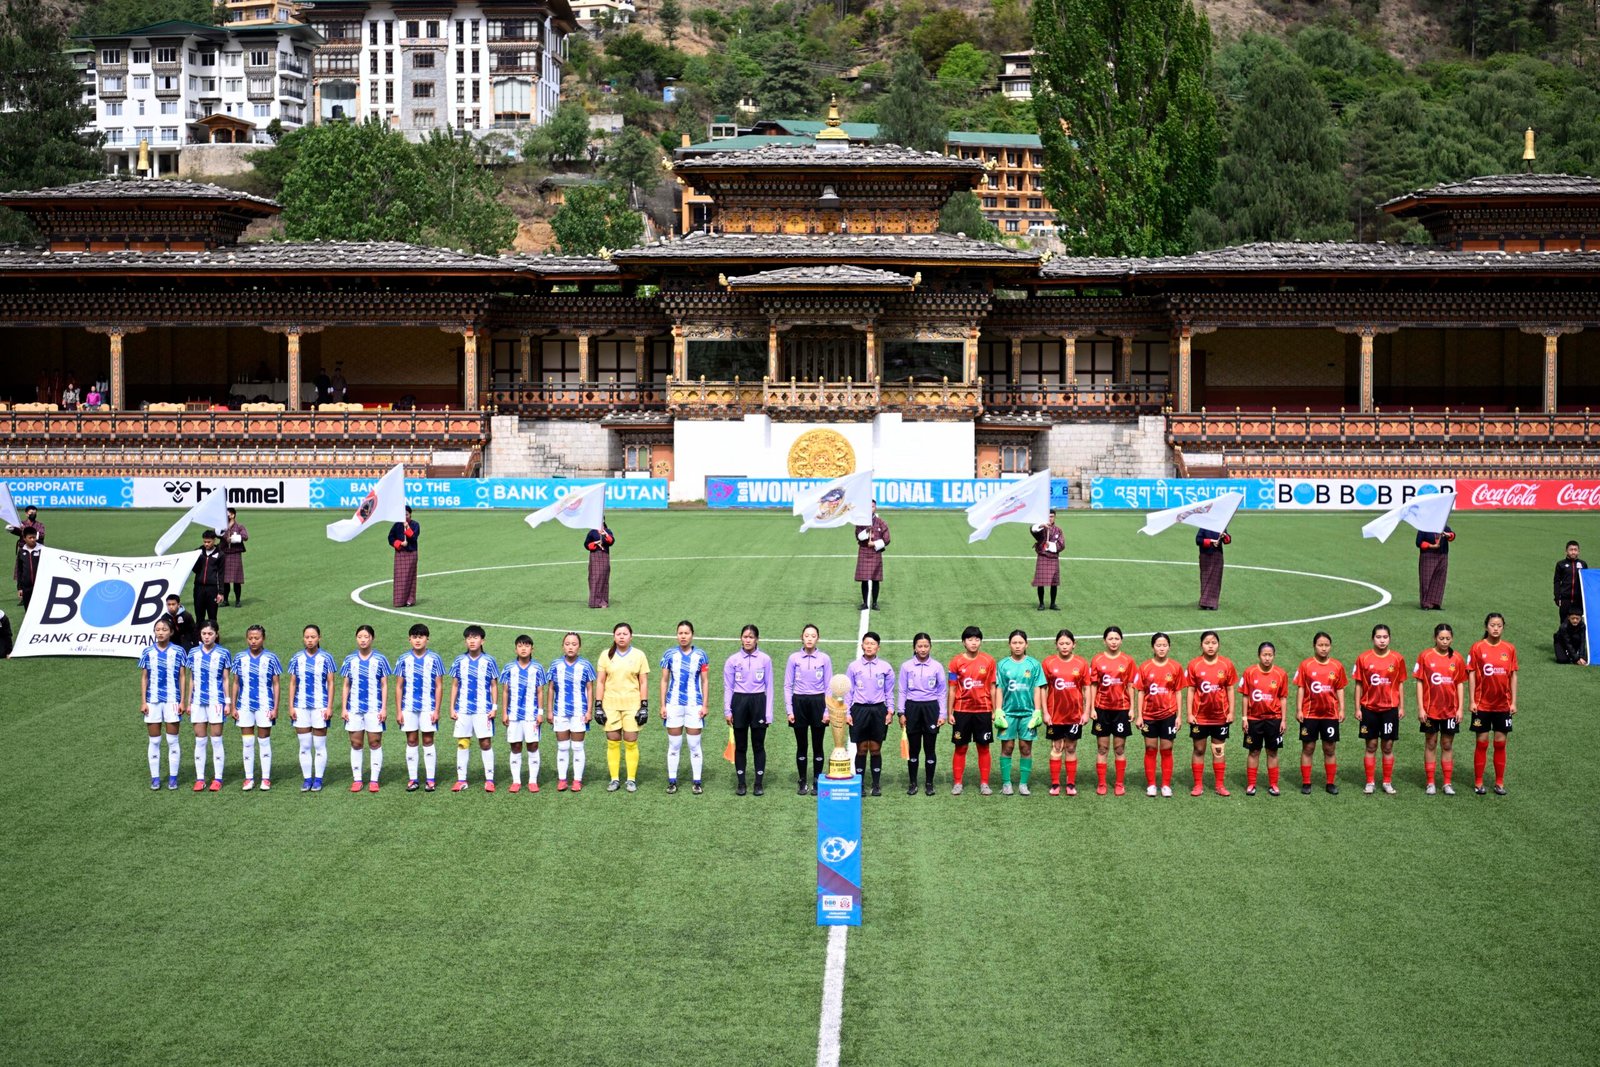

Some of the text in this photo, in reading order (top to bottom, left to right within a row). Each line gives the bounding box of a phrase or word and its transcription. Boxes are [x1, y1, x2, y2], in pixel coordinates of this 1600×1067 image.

[9, 481, 84, 491] CORPORATE
[350, 482, 451, 492] BAN TO THE
[872, 481, 935, 503] TIONAL
[493, 485, 548, 500] BANK
[605, 485, 666, 500] HUTAN
[1471, 483, 1540, 506] Coca-Cola
[12, 495, 107, 505] RNET BANKING
[340, 496, 461, 506] NAT NCE 1968
[29, 633, 74, 645] BANK
[76, 632, 99, 643] OF
[1117, 723, 1125, 733] 8
[1383, 722, 1393, 735] 18
[1447, 718, 1456, 730] 16
[1326, 726, 1335, 738] 9
